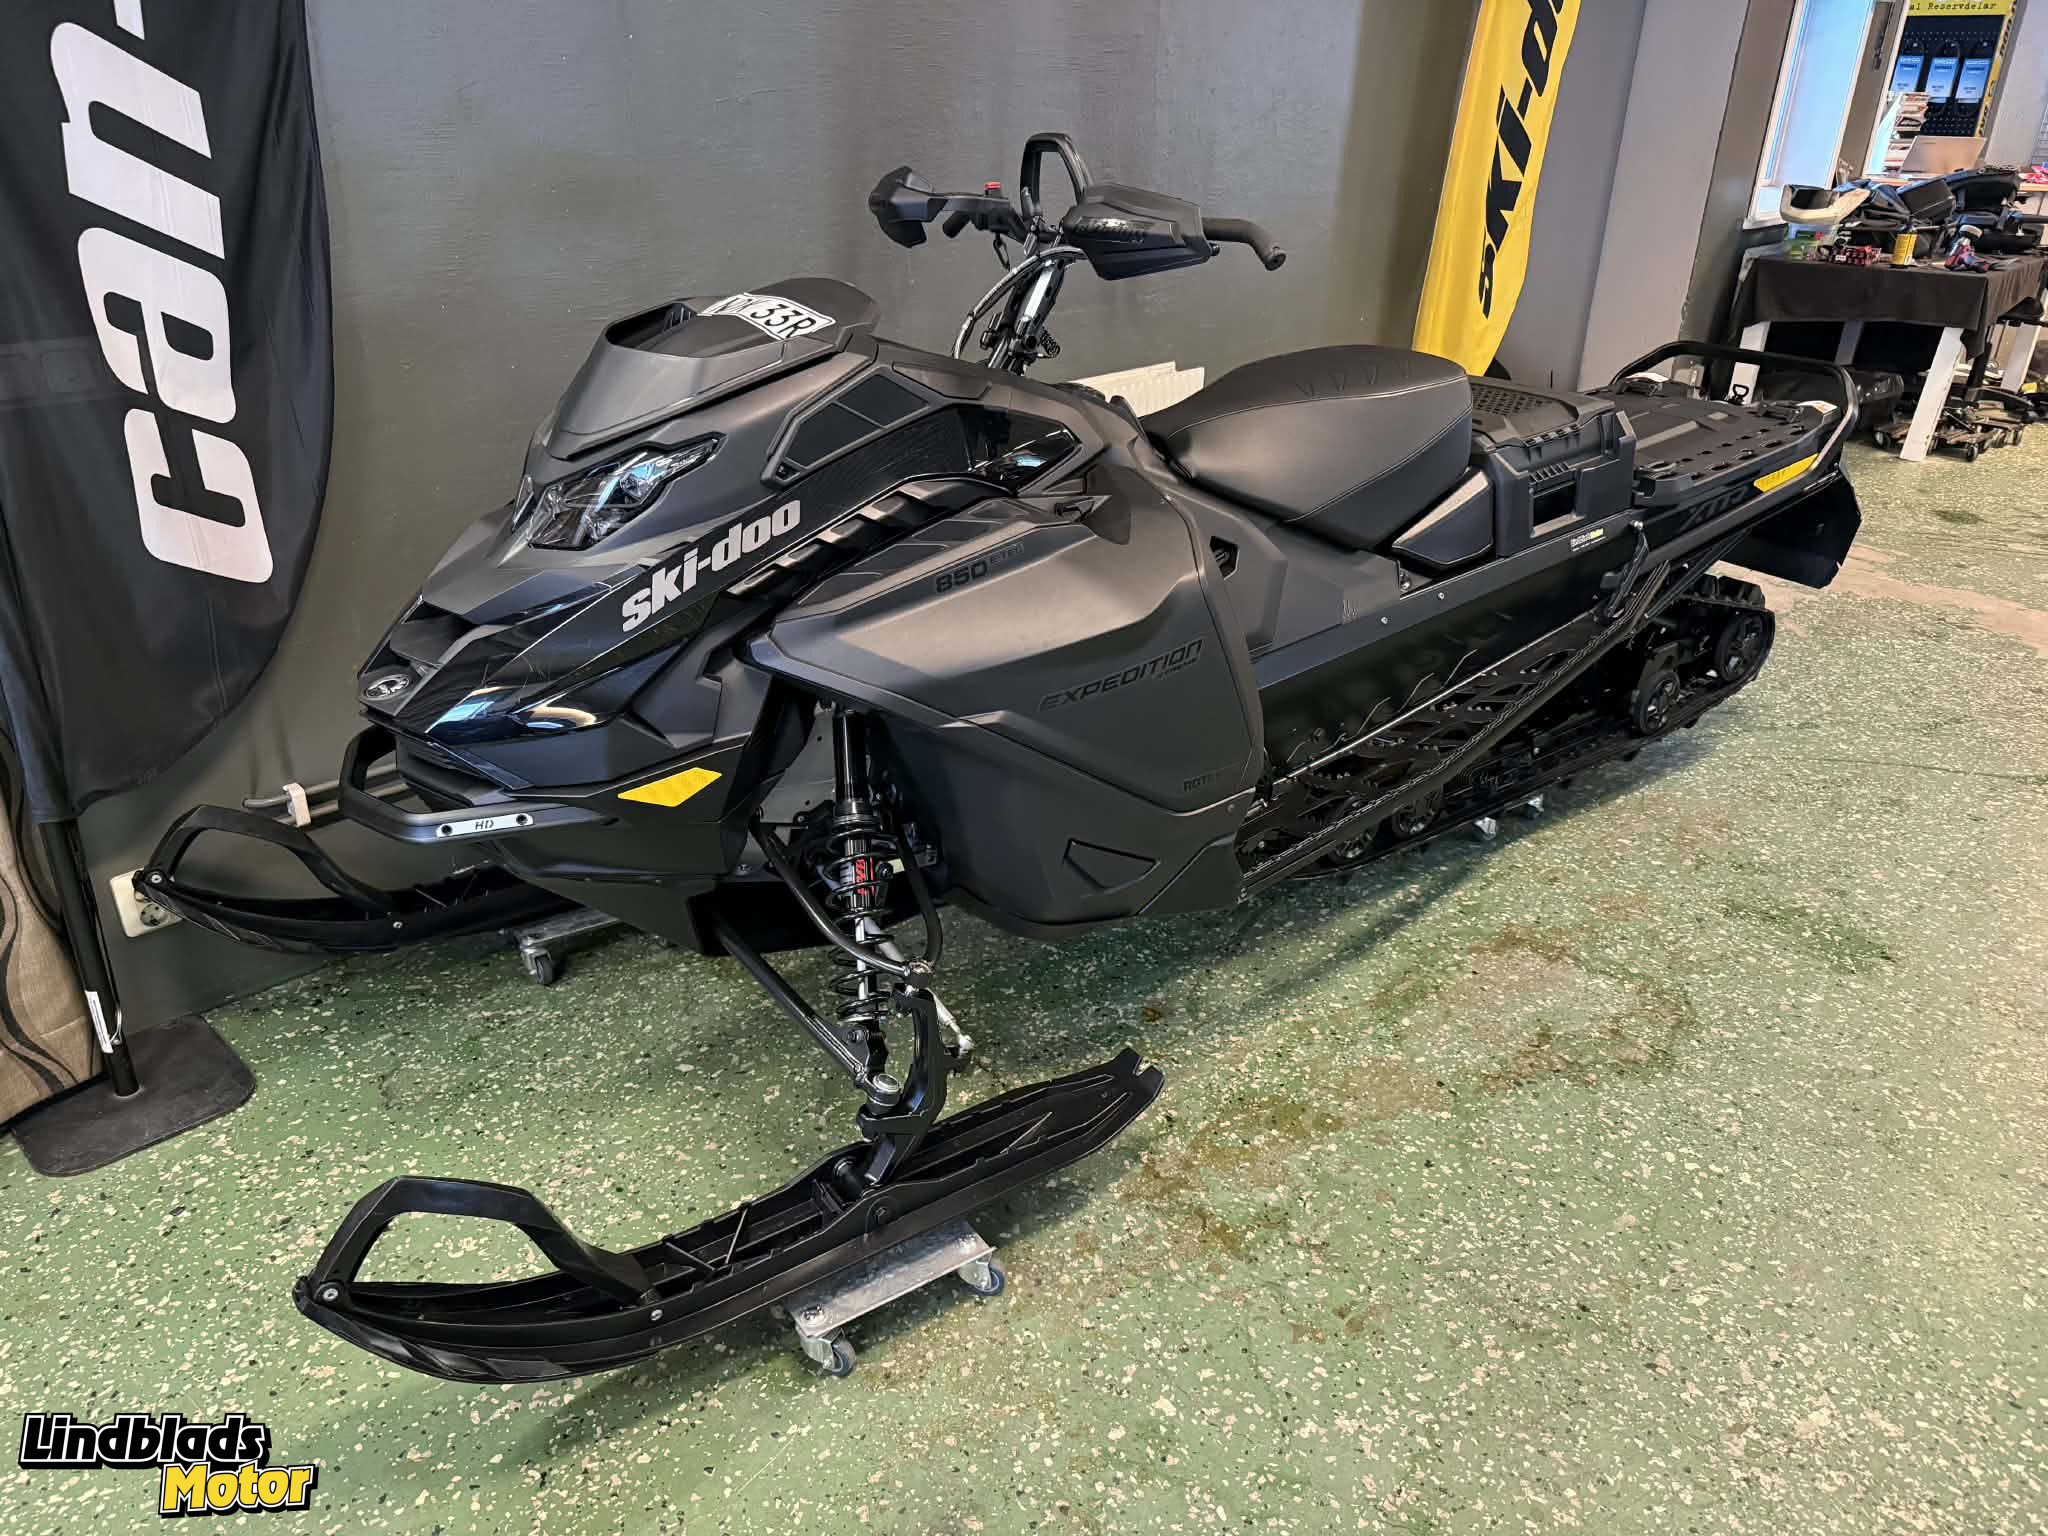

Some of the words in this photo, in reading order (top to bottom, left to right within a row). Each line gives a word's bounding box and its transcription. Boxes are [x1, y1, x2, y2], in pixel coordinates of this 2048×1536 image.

[749, 303, 817, 338] 33R
[622, 500, 801, 632] ski-doo
[936, 560, 988, 592] 850
[1038, 638, 1204, 712] EXPEDITION
[474, 819, 495, 830] HD
